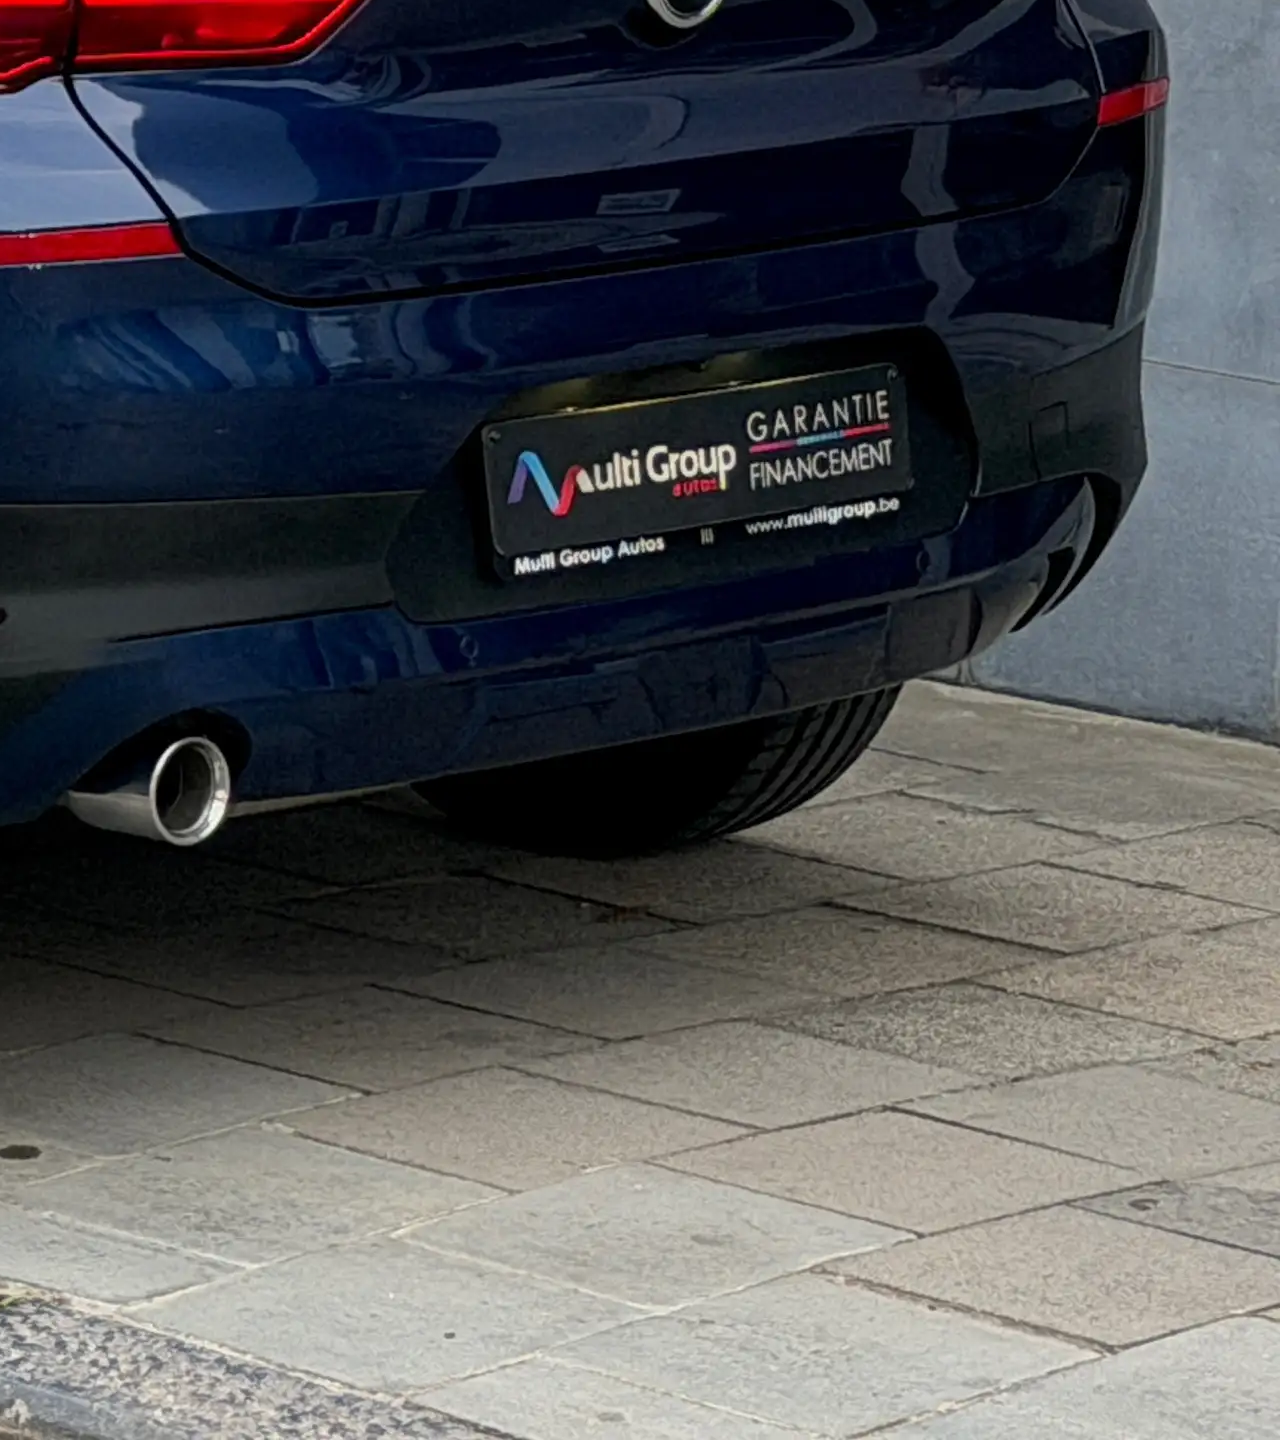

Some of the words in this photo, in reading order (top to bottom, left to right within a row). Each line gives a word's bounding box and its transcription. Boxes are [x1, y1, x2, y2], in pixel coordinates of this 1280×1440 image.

[746, 390, 890, 441] GARANTIE
[506, 449, 641, 517] Multi
[646, 443, 737, 490] Group
[749, 438, 893, 491] FINANCEMENT
[745, 497, 901, 535] www.multigroup.be
[514, 552, 556, 575] Multi
[559, 545, 614, 564] Group
[618, 536, 665, 557] Autos
